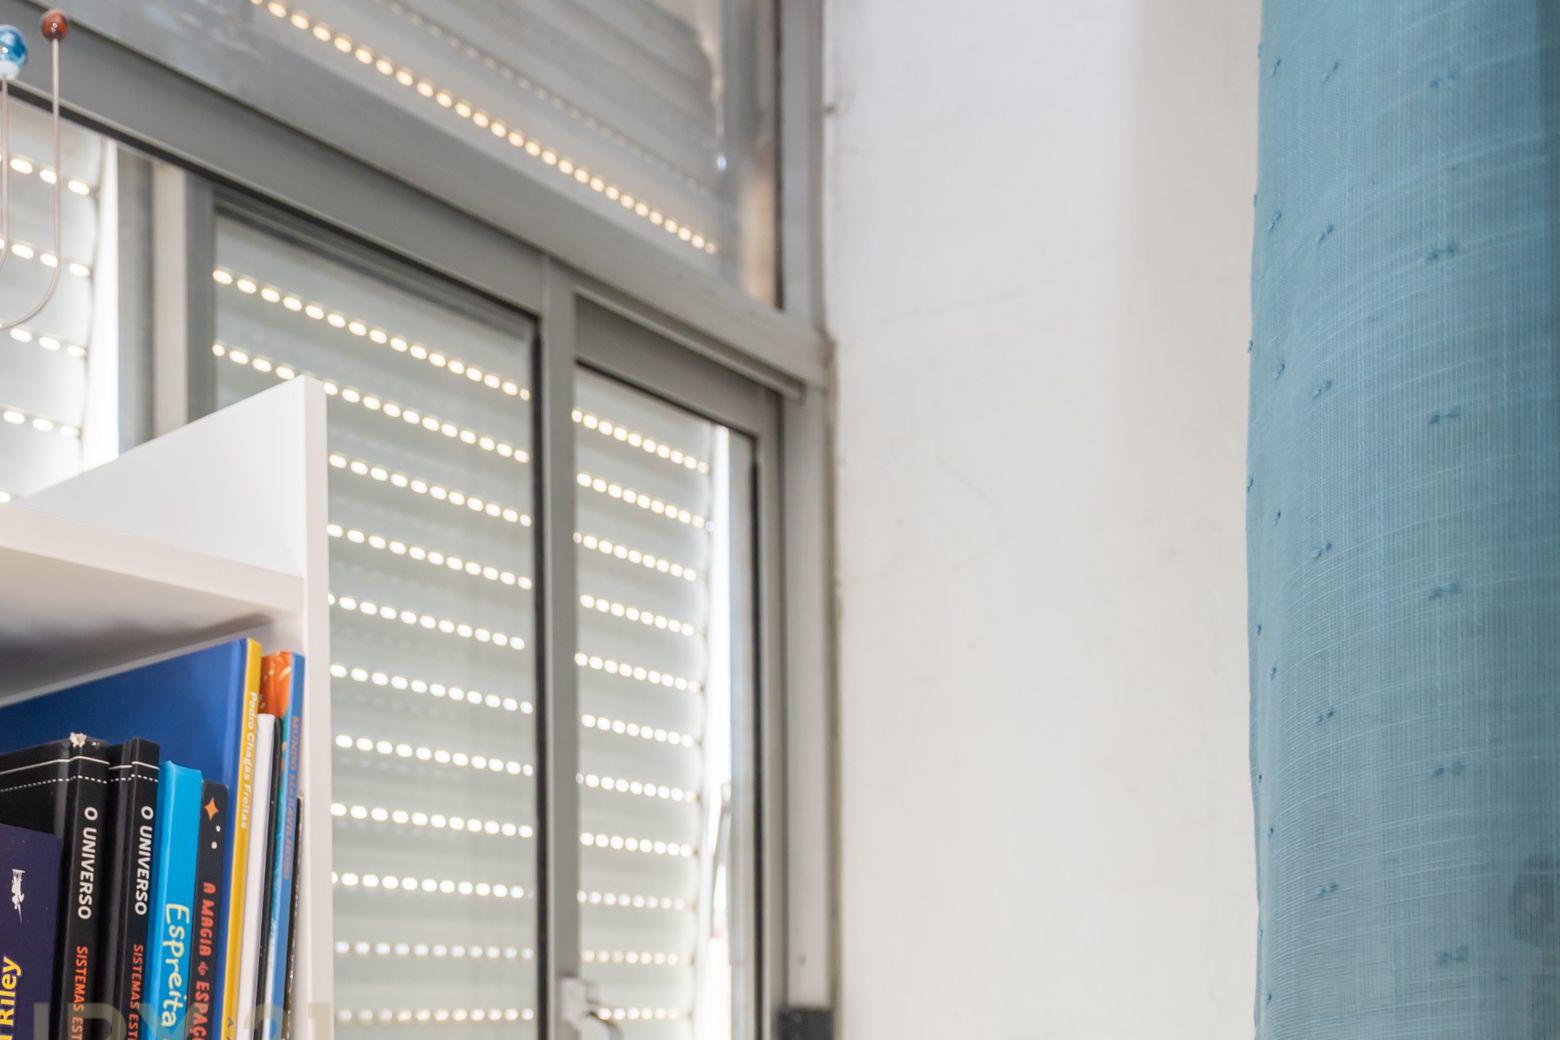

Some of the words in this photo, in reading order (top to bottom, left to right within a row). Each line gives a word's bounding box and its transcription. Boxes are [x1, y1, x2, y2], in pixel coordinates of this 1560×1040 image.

[78, 828, 96, 919] UNIVERSO
[135, 826, 152, 915] UNIVERSO
[161, 903, 190, 1028] Espreita
[199, 900, 215, 955] MAGIA
[73, 946, 88, 1012] SISTEMAS
[129, 944, 143, 1010] SISTEMAS
